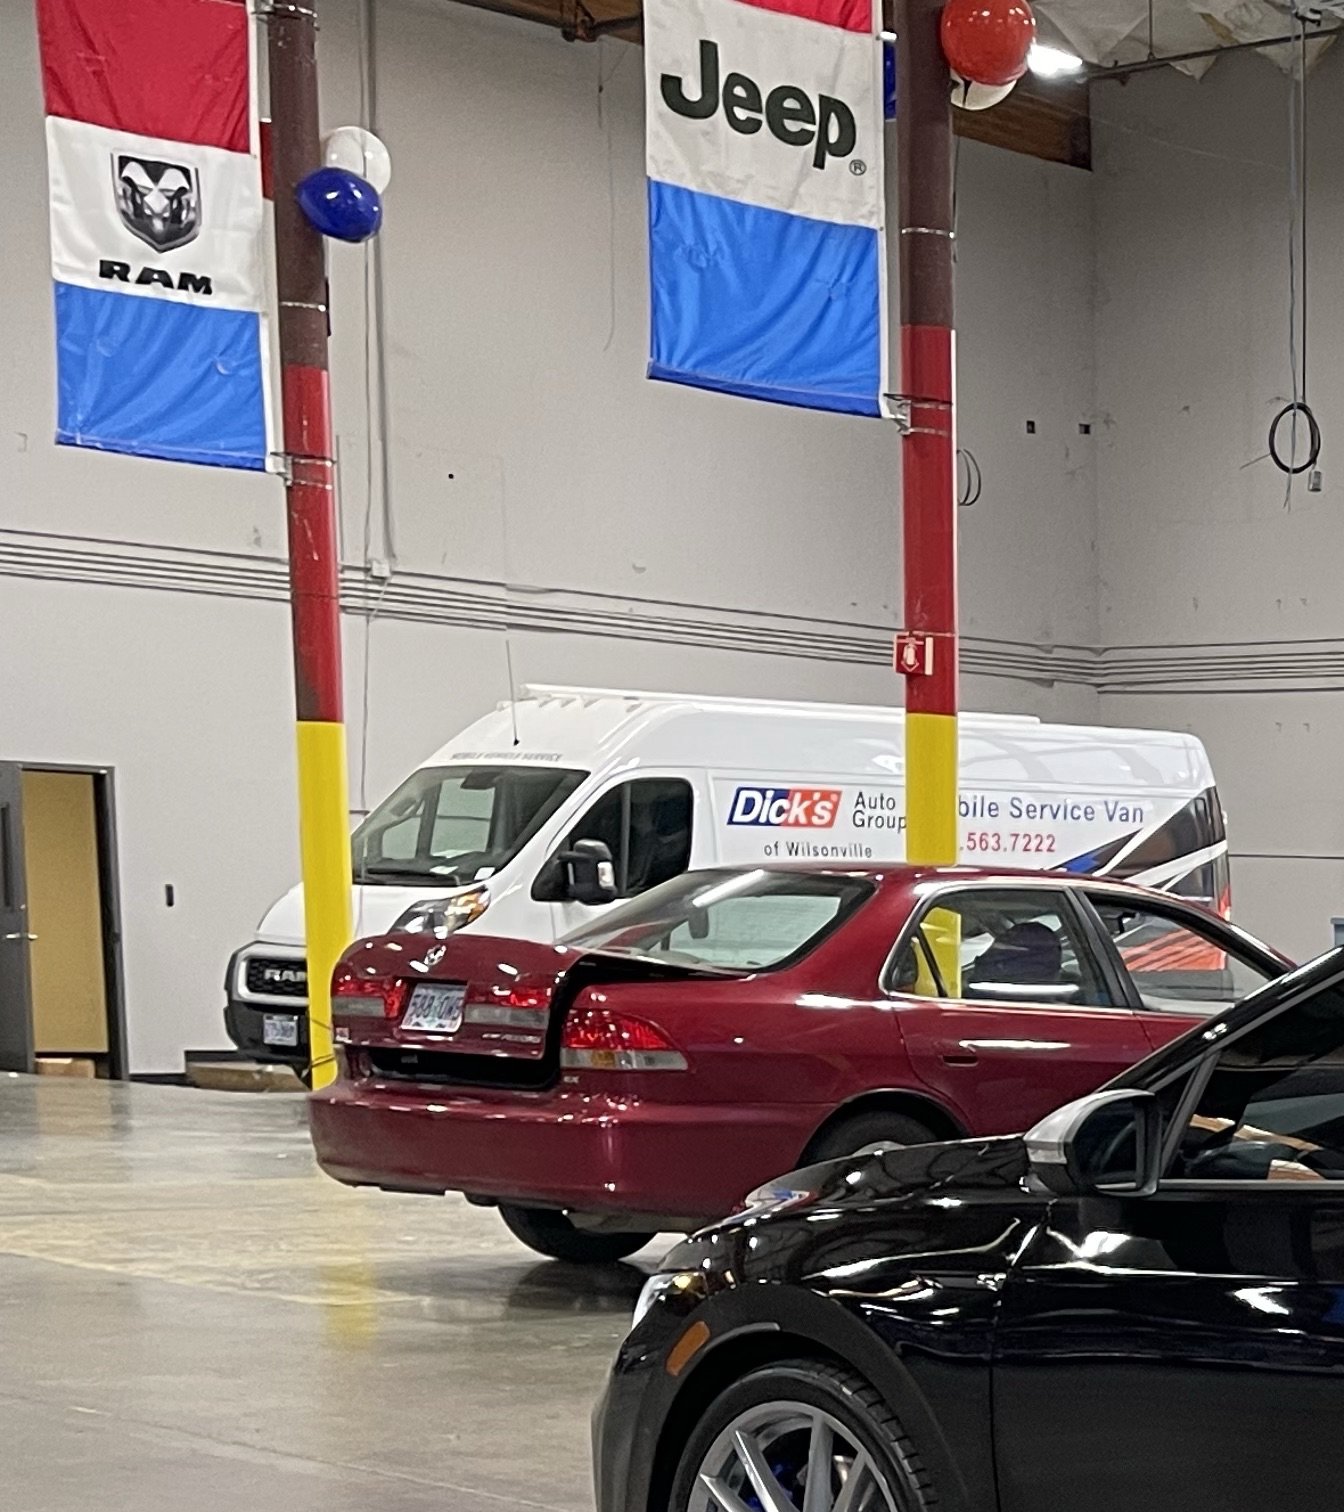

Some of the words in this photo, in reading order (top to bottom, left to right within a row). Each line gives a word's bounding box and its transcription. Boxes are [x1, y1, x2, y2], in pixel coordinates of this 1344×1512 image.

[660, 39, 857, 170] Jeep
[99, 259, 212, 295] RAM
[854, 791, 896, 811] Auto
[957, 795, 1000, 818] bile
[1009, 797, 1095, 822] Service
[1104, 800, 1144, 824] Van
[852, 811, 908, 834] Group
[764, 841, 779, 857] of
[785, 841, 872, 858] Wilsonville
[958, 832, 1056, 853] .563.7222
